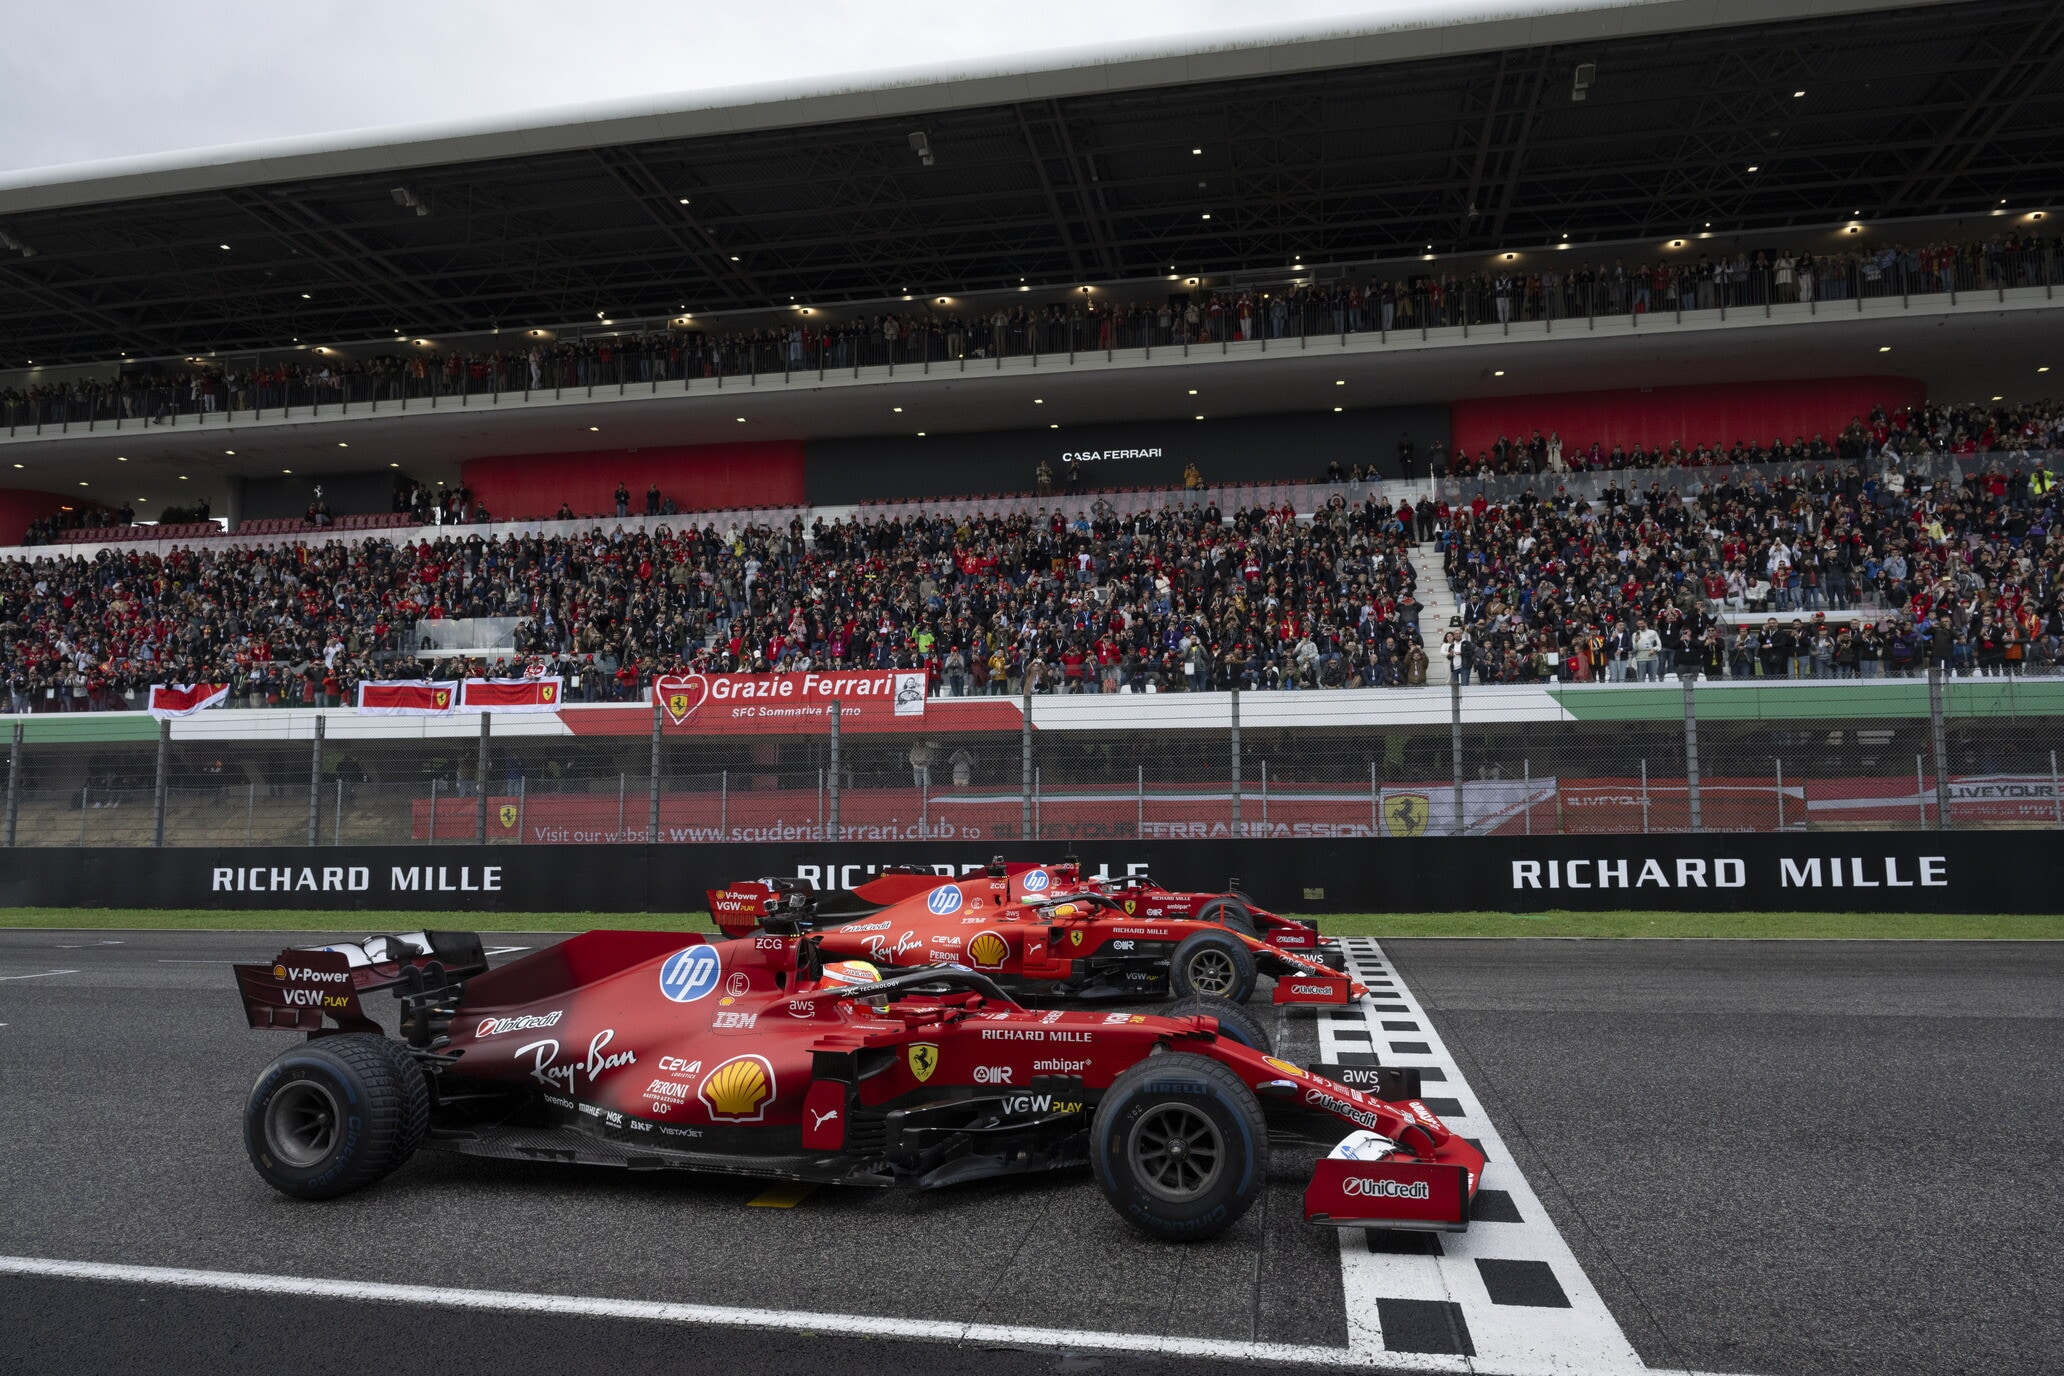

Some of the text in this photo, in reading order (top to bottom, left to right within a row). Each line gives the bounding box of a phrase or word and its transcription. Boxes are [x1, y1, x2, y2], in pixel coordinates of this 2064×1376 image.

[1062, 448, 1162, 462] CASA FERRARI
[711, 673, 893, 699] Grazie Ferrari
[731, 705, 861, 718] SFC Sommariva Prno
[1949, 785, 2055, 798] LIVEYOUR
[534, 826, 569, 842] Visit
[573, 830, 601, 842] our
[604, 826, 665, 842] websie
[962, 826, 980, 839] to
[211, 866, 502, 891] RICHARD MILLE
[1511, 856, 1948, 889] RICHARD MILLE
[990, 882, 1006, 890] ZCG
[1027, 870, 1047, 891] hp
[725, 892, 757, 900] V-Power
[931, 885, 959, 915] hp
[716, 901, 741, 911] VGW
[851, 920, 892, 932] UniCredit
[960, 917, 986, 925] IBM
[755, 938, 782, 950] ZCG
[929, 949, 959, 960] PERONI
[288, 968, 349, 983] V-Power
[665, 945, 715, 1001] hp
[1126, 972, 1147, 980] VGW
[860, 981, 900, 992] TECHNOLOGY
[1300, 985, 1333, 996] UniCredit
[282, 989, 349, 1007] VGW PLAY
[789, 1000, 814, 1011] aws
[494, 1011, 563, 1035] UniCredit
[712, 1012, 757, 1029] IBM
[981, 1029, 1092, 1043] RICHARD MILLE
[1033, 1058, 1084, 1073] ambipar
[1343, 1069, 1379, 1084] aws
[646, 1079, 690, 1098] PERONI
[1143, 1077, 1208, 1094] PIRELLI
[543, 1093, 574, 1110] brembo
[1001, 1094, 1083, 1115] VGW PLAY
[578, 1102, 601, 1117] MAHLE
[606, 1110, 623, 1124] NGK
[1321, 1094, 1378, 1129] UniCredit
[630, 1120, 653, 1132] SKF
[1360, 1180, 1429, 1200] UniCredit
